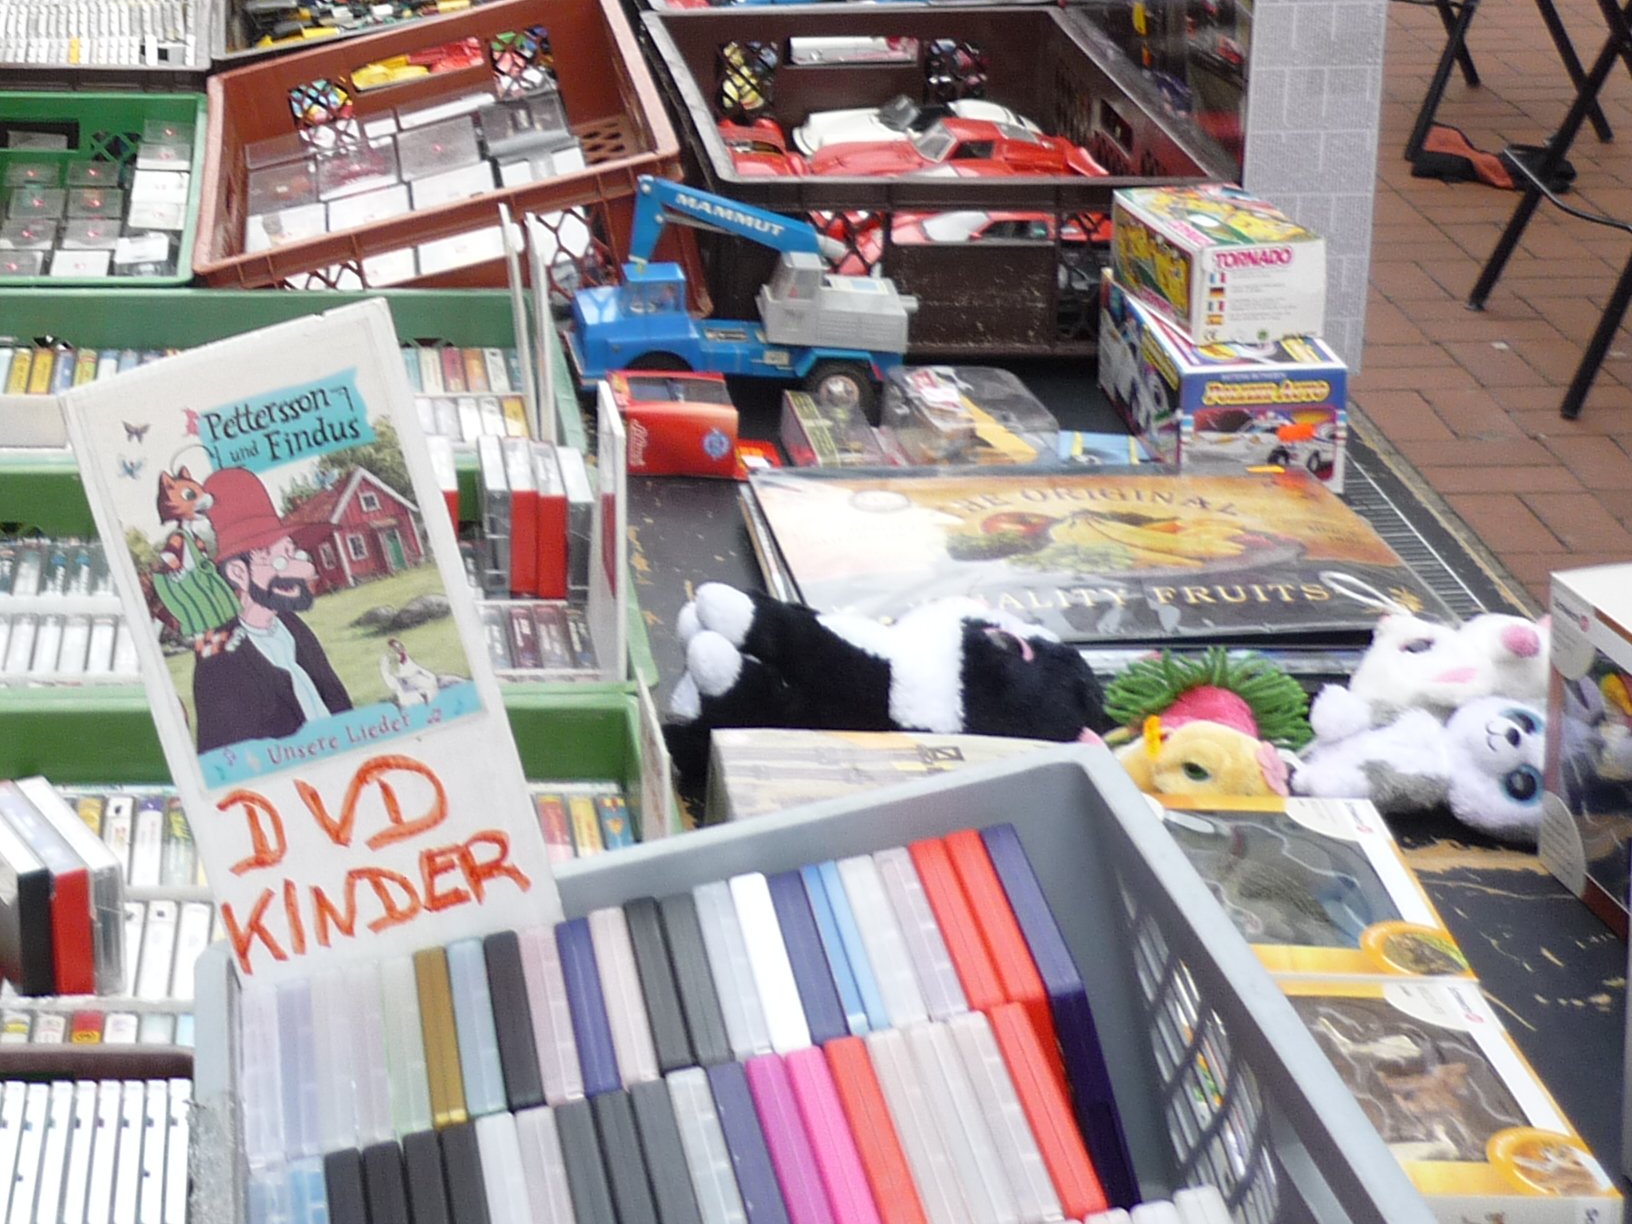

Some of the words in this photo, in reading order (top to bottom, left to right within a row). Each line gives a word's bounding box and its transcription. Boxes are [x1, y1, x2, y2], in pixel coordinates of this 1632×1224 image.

[675, 193, 785, 237] MAMMUT
[1215, 247, 1292, 268] TORNADO
[204, 387, 331, 441] Pettersson
[230, 439, 259, 463] und
[264, 416, 360, 462] Findus
[1019, 487, 1240, 516] ORIGINAL
[986, 585, 1127, 612] ALITY
[1152, 582, 1332, 605] FRUITS
[267, 733, 339, 765] Unsere
[345, 713, 411, 744] Lieder
[216, 753, 449, 877] DVD
[220, 828, 532, 976] KINDER
